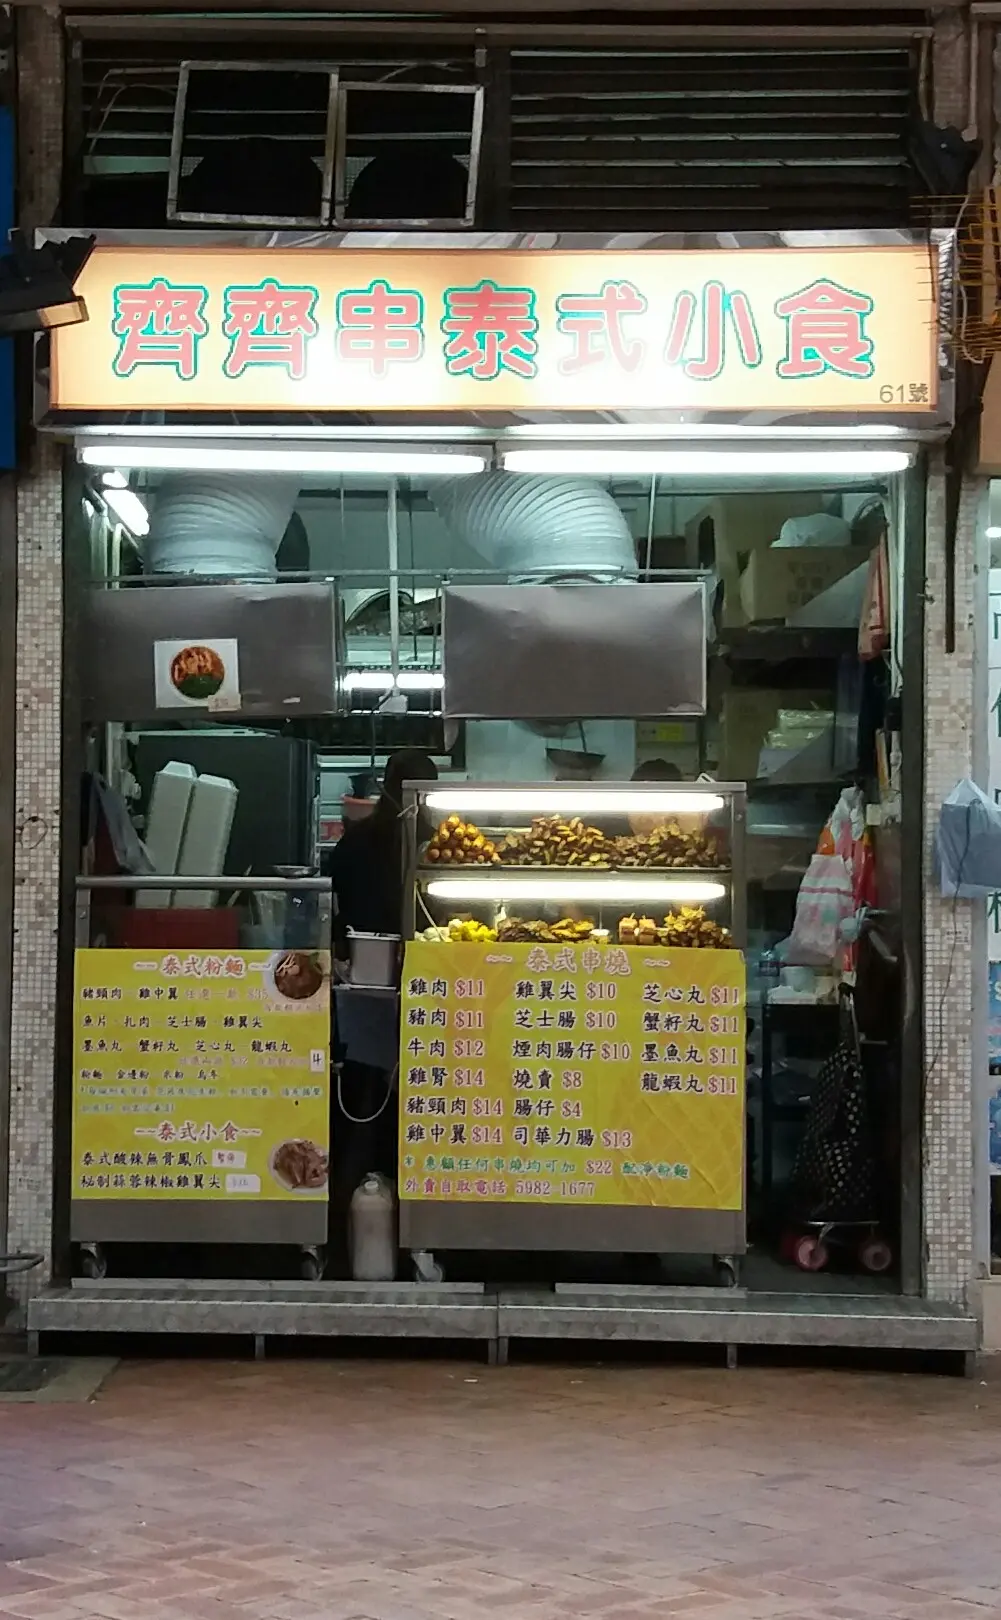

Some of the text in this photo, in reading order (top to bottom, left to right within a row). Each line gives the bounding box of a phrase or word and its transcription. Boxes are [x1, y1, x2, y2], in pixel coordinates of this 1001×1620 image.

[113, 277, 874, 379] 齊齊串泰式小食
[880, 383, 928, 403] 61號
[162, 955, 245, 976] 泰式粉麵
[528, 948, 630, 974] 泰式串燒
[409, 979, 484, 997] 雞肉 $11
[516, 981, 616, 1000] 雞翼尖 $10
[644, 984, 738, 1004] 芝心丸 $11
[82, 1016, 106, 1028] 魚片
[167, 1015, 207, 1028] 芝士腸
[223, 1015, 264, 1028] 雞翼尖
[408, 1008, 484, 1028] 豬肉 $11
[516, 1009, 616, 1028] 芝士腸 $10
[644, 1012, 738, 1033] 蟹籽丸 $11
[81, 1040, 122, 1053] 墨魚丸
[195, 1040, 236, 1053] 芝心丸
[251, 1040, 292, 1053] 龍蝦丸
[408, 1038, 484, 1057] 牛肉 $12
[513, 1040, 630, 1060] 煙肉腸仔 $10
[642, 1043, 738, 1064] 墨魚丸 $11
[408, 1067, 484, 1087] 雞腎 $14
[513, 1070, 582, 1089] 燒賣 $8
[641, 1073, 737, 1094] 龍蝦丸 $11
[407, 1096, 503, 1115] 豬頸肉 $14
[514, 1098, 581, 1118] 腸仔 $4
[158, 1122, 238, 1142] 泰式小食
[406, 1124, 502, 1143] 雞中翼 $14
[514, 1126, 632, 1148] 司華力腸 $13
[82, 1151, 208, 1166] 泰式酸辣無骨鳳爪
[586, 1159, 612, 1175] $22
[405, 1177, 507, 1195] 外賣自取電話
